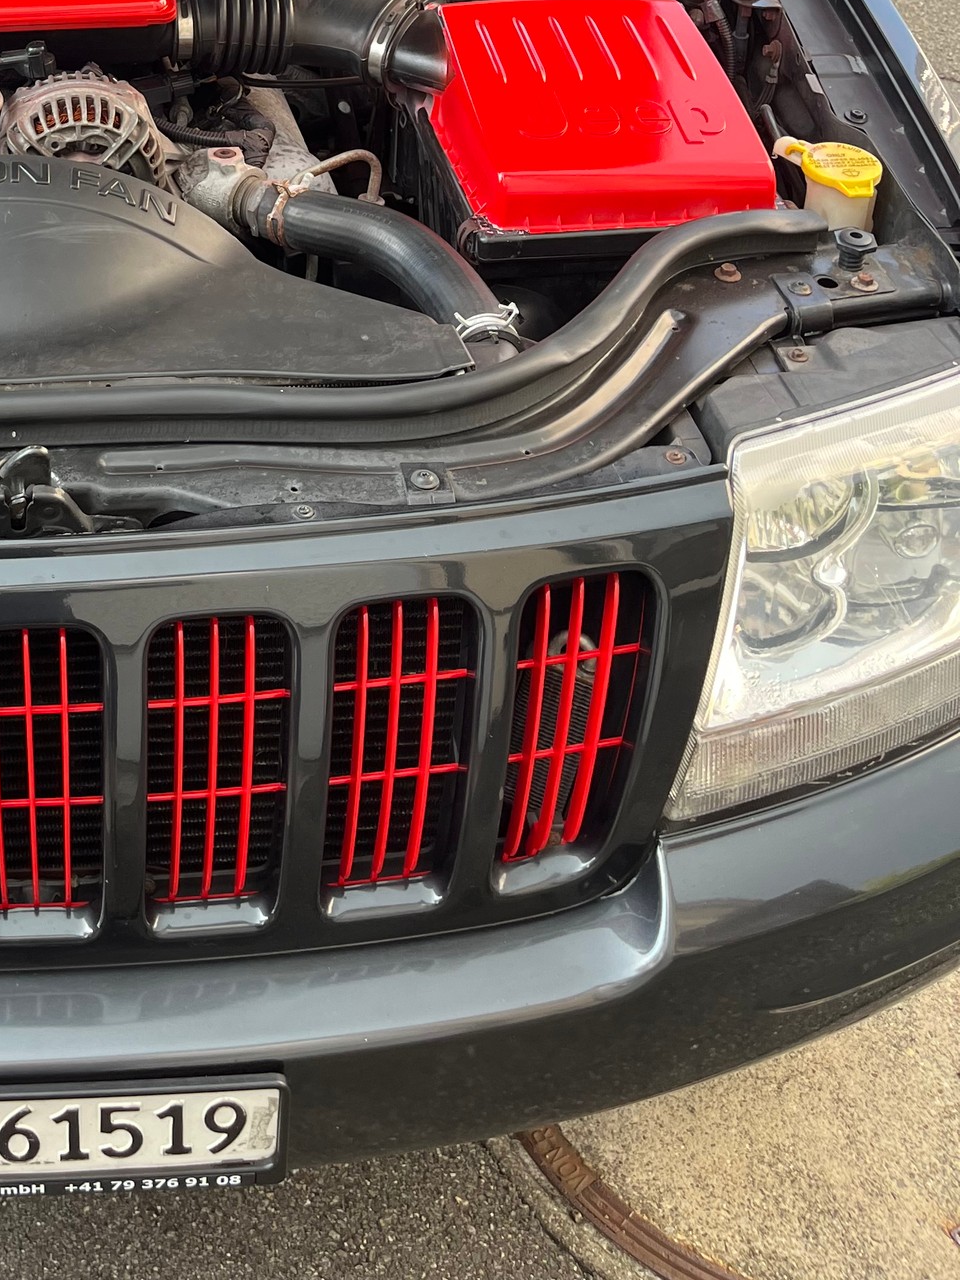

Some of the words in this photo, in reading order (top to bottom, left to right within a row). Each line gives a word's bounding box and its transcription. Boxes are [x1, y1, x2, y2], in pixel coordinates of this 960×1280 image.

[518, 91, 727, 145] Jeep
[69, 166, 181, 227] FAN
[64, 1181, 104, 1194] +41
[110, 1179, 136, 1192] 79
[141, 1177, 180, 1190] 376
[184, 1176, 210, 1188] 91
[215, 1174, 242, 1187] 08
